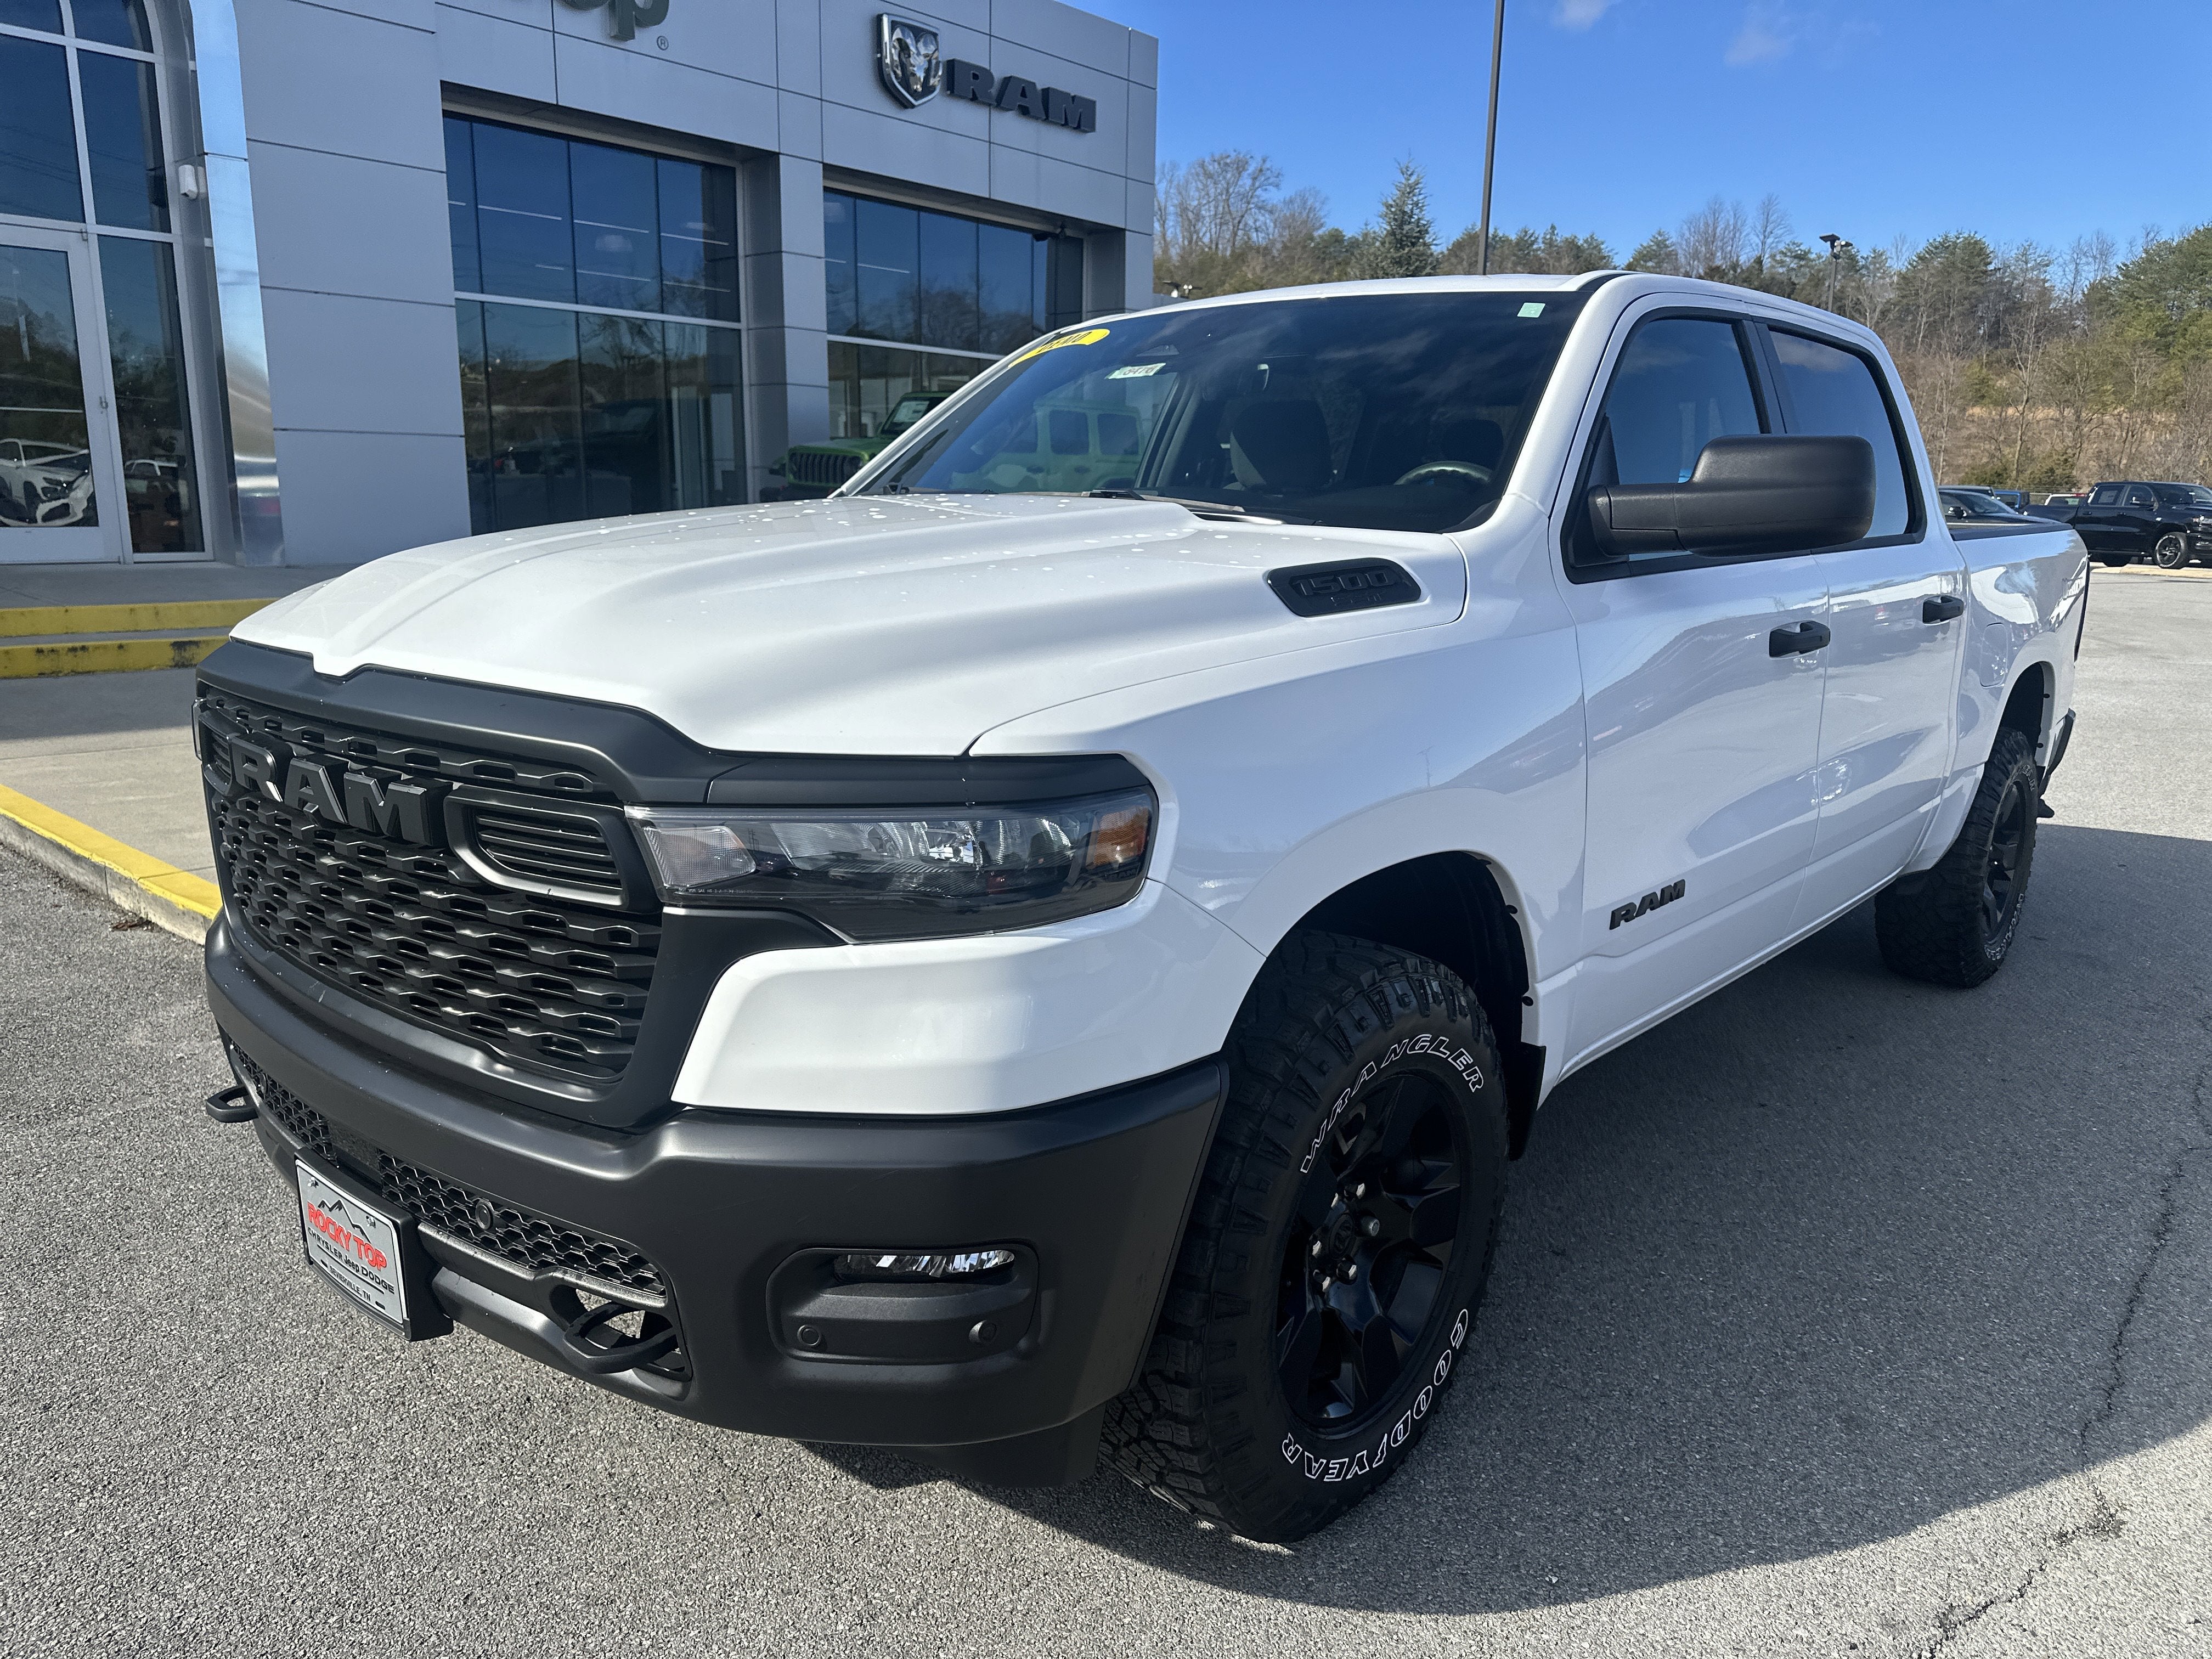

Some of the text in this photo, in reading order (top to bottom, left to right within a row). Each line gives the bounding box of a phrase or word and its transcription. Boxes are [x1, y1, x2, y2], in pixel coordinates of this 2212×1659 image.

[946, 58, 1096, 132] RAM
[1291, 571, 1396, 596] 1500
[232, 732, 436, 846] RAM
[1609, 879, 1685, 930] RAM
[1300, 1034, 1484, 1173] WRANGLER
[307, 1201, 387, 1271] ROCKY TOP
[308, 1226, 394, 1295] CHRYSLER Jeep DODGE
[362, 1291, 371, 1302] TN
[1282, 1308, 1468, 1481] GOODYEAR
